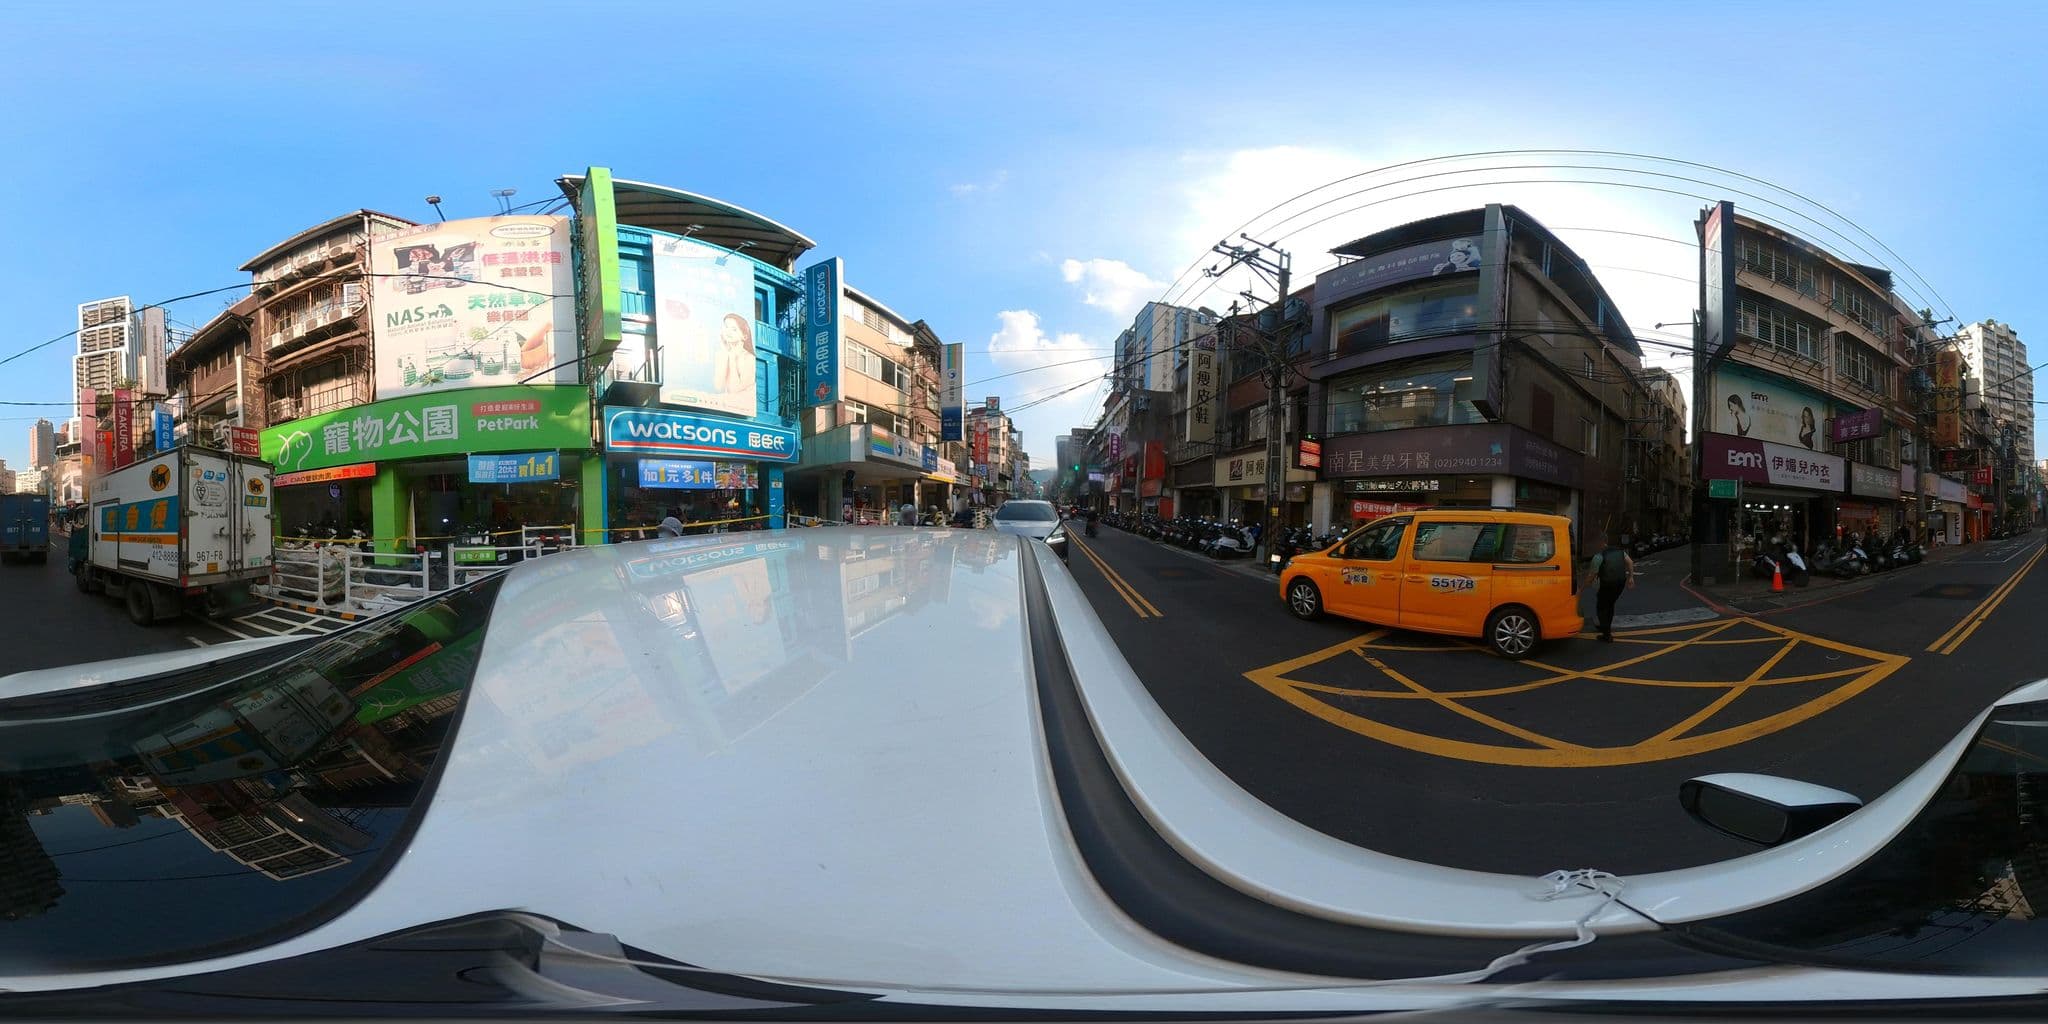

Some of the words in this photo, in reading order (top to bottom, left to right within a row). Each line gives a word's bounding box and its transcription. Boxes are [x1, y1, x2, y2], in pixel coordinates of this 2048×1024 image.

[817, 271, 825, 318] watsons
[387, 306, 425, 328] NAS
[816, 331, 829, 376] 屈臣氏
[118, 408, 128, 452] SAKURA
[323, 404, 459, 455] 寵物公園
[477, 416, 539, 431] PetPark
[627, 420, 737, 445] watsons
[749, 432, 785, 450] 屈臣氏
[1328, 450, 1431, 473] 南星美學牙醫
[1772, 456, 1830, 478] 伊媚兒內衣
[196, 550, 223, 562] 967-F8
[1431, 576, 1474, 590] 55178
